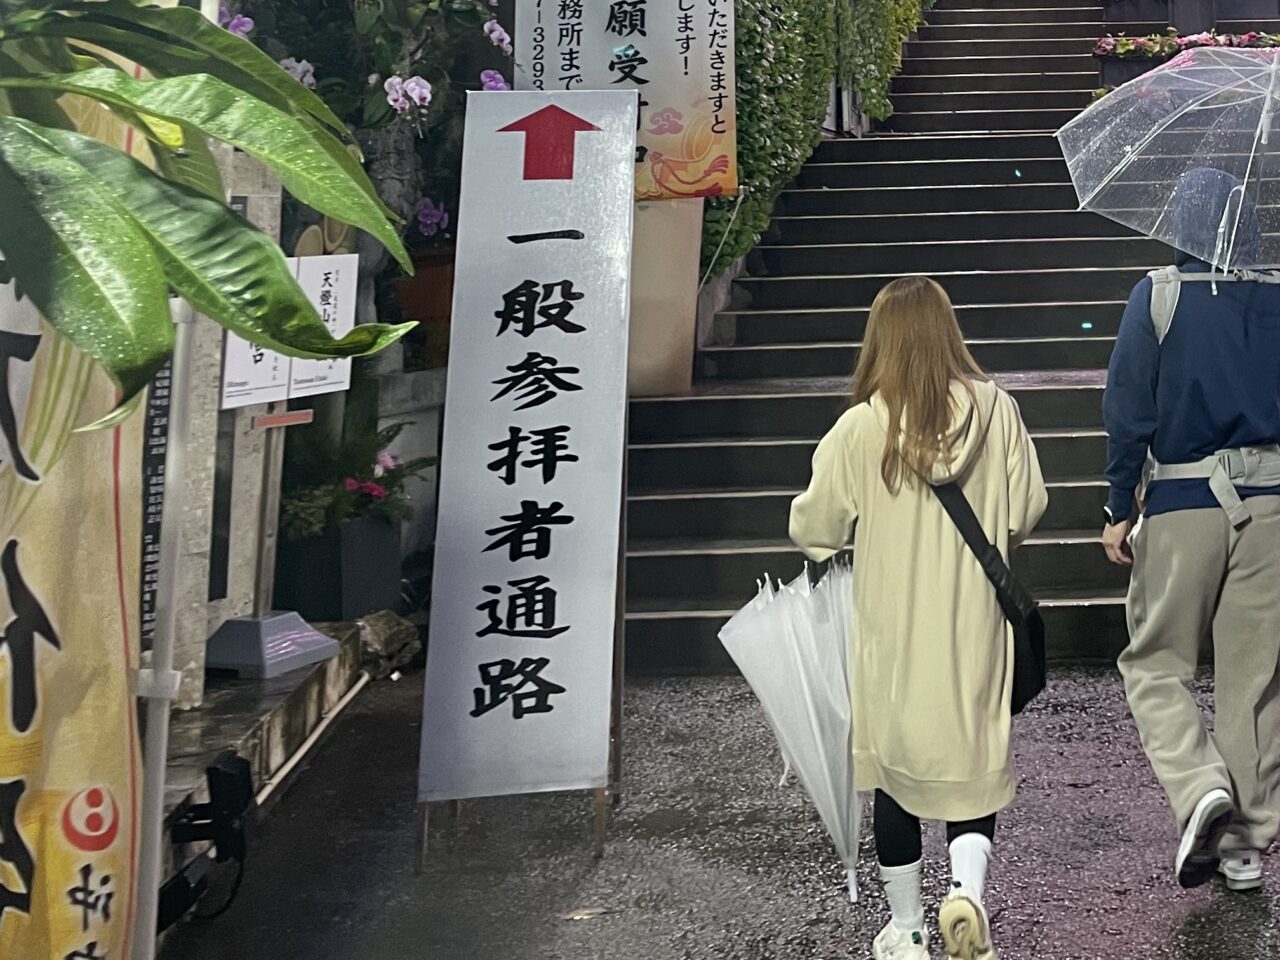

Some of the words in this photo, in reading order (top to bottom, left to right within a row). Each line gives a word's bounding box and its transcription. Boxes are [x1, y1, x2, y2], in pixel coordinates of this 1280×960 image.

[468, 229, 587, 720] 一般参拝者通路
